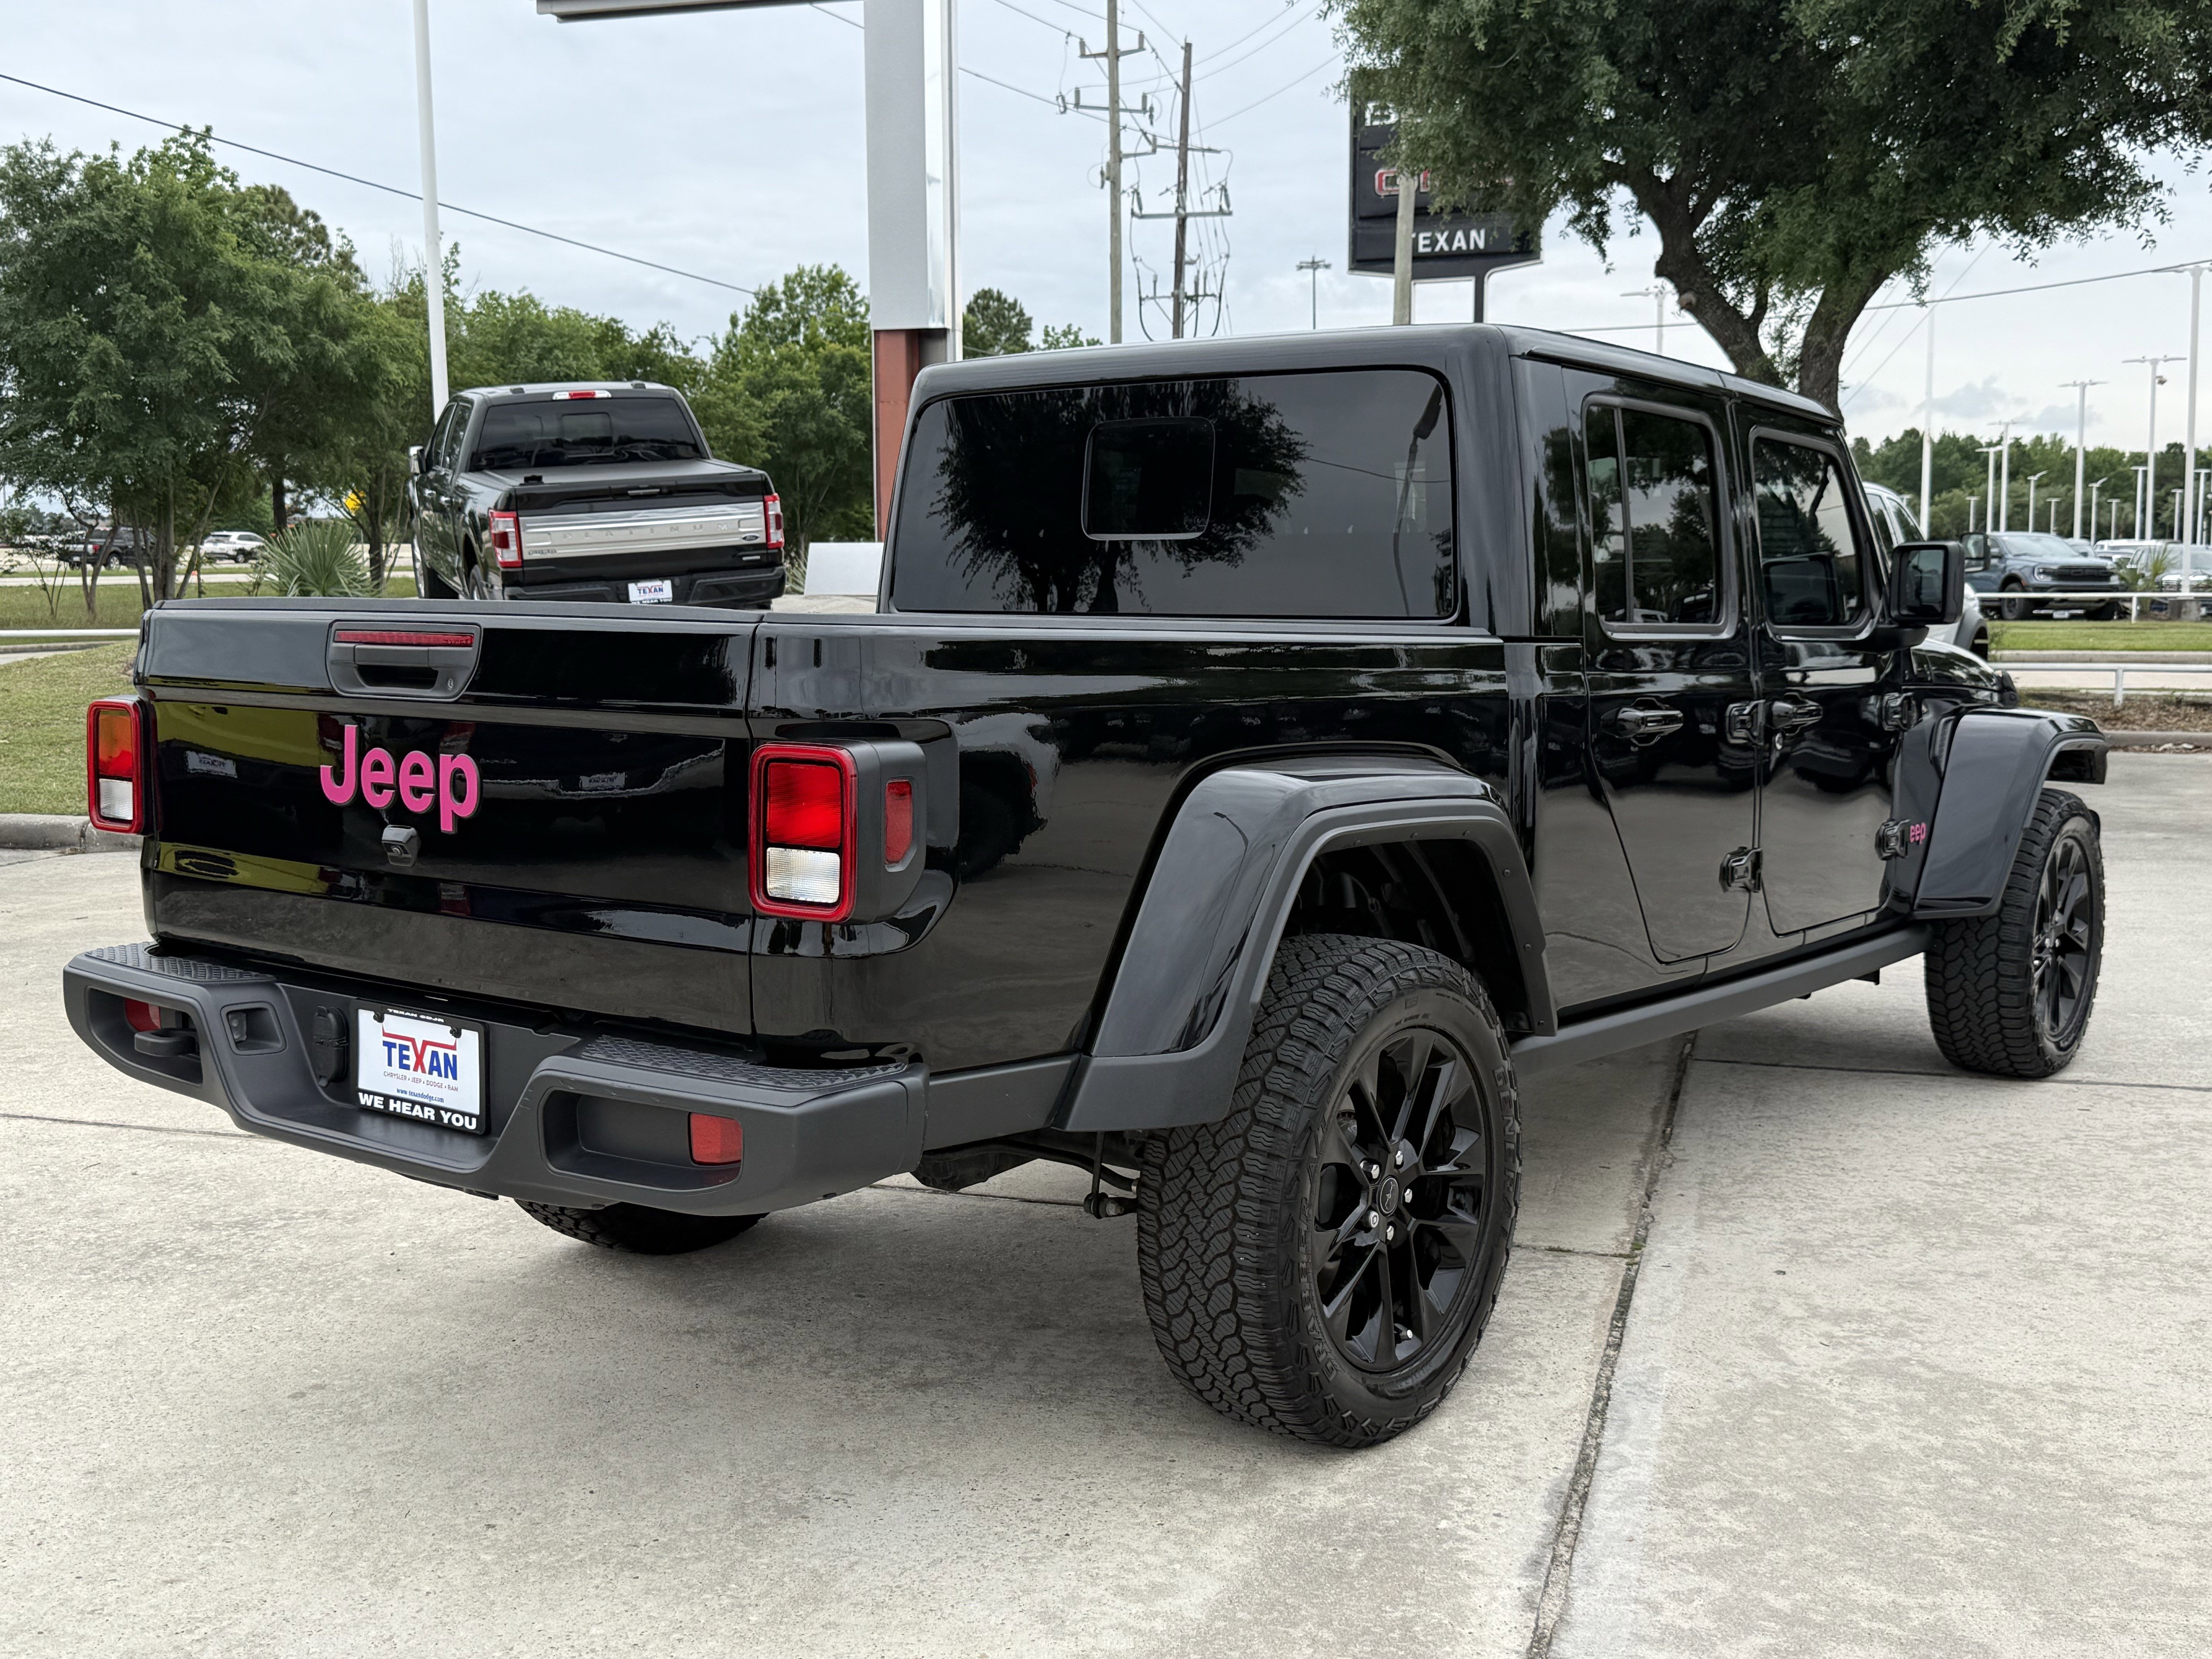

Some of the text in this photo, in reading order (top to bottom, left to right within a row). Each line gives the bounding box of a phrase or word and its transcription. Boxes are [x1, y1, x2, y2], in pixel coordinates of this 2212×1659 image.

[1412, 229, 1486, 253] EXAN
[637, 585, 663, 594] TEXAN
[320, 725, 482, 833] Jeep
[1910, 823, 1926, 845] eep
[387, 1008, 417, 1017] TEXAN
[382, 1035, 458, 1081] TEXAN
[384, 1071, 407, 1080] CHRYSLER
[426, 1080, 443, 1089] DODGE
[358, 1092, 477, 1130] WE HEAR YOU
